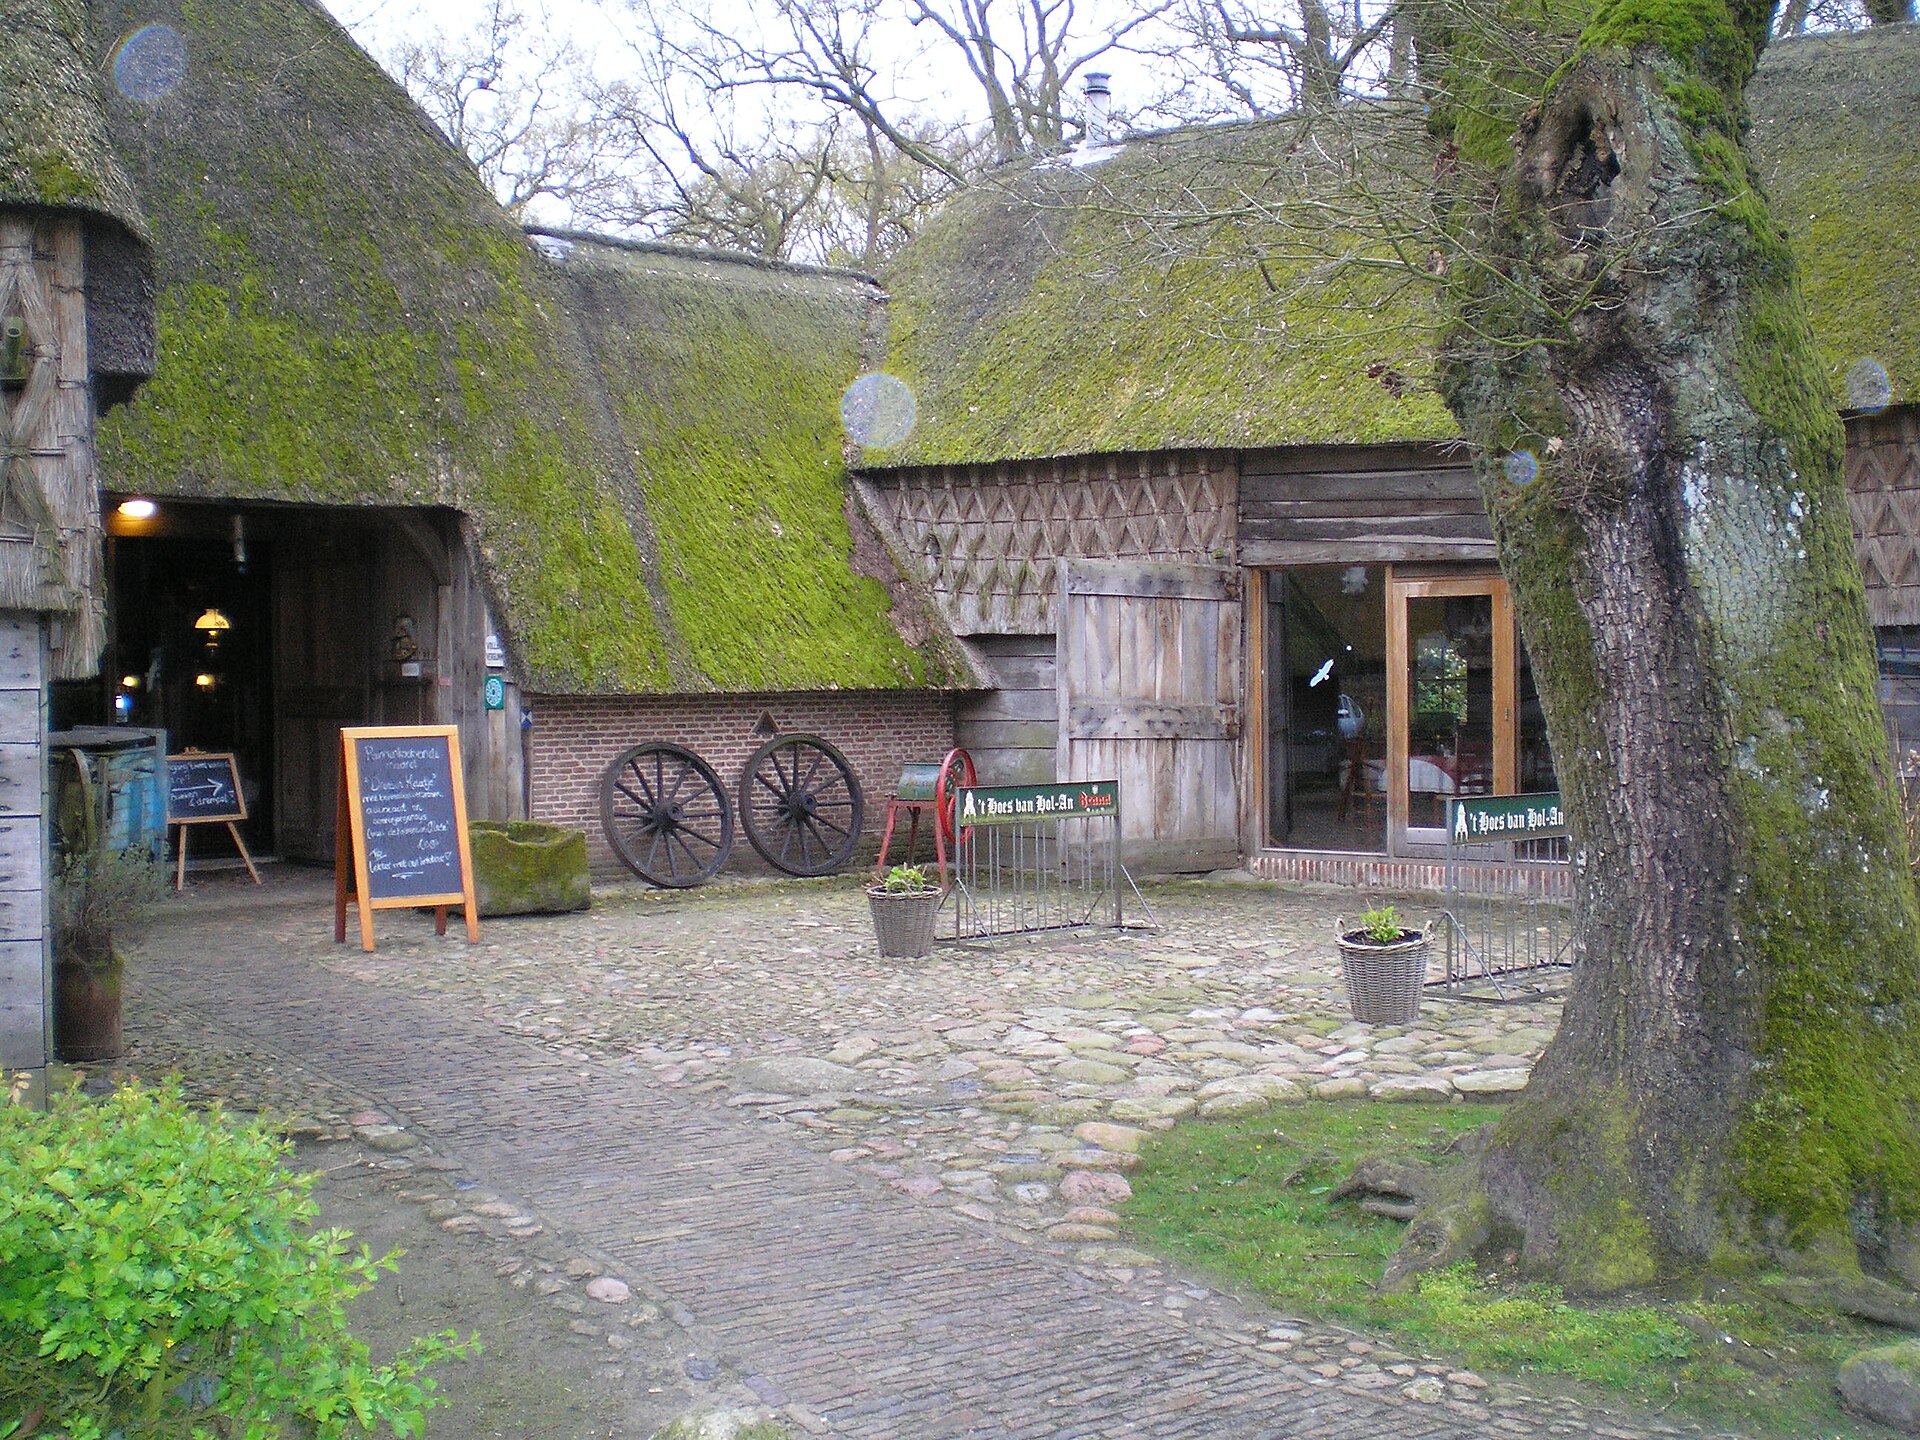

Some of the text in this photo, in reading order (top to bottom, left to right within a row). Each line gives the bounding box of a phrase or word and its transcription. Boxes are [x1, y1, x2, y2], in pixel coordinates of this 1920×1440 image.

[977, 791, 1111, 817] 't Hoes van Hol-An Brand
[1470, 806, 1565, 836] 't Hoes van Hol-An
